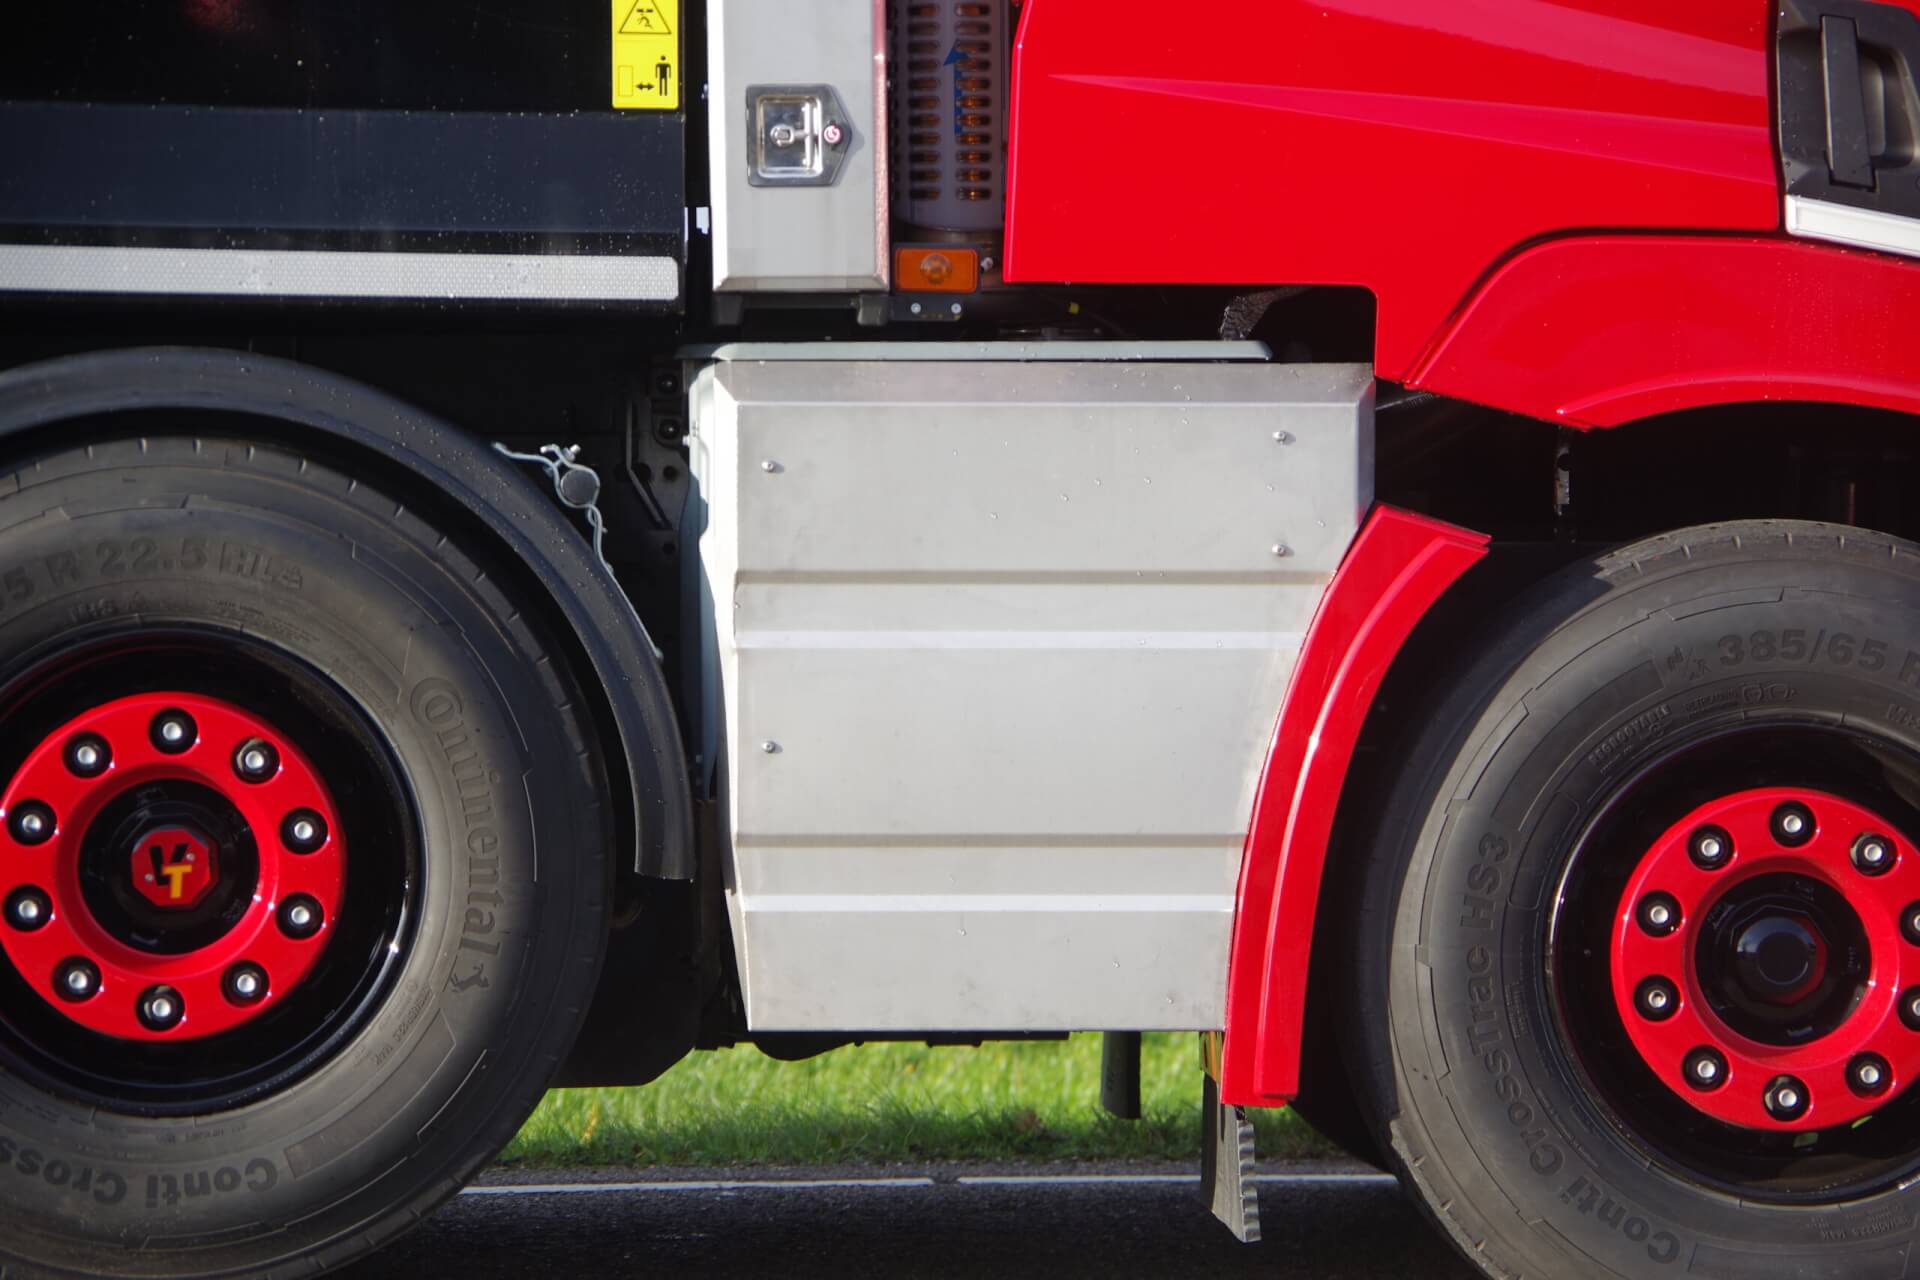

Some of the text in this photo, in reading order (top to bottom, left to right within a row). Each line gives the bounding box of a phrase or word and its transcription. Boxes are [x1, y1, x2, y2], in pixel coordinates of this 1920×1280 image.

[0, 565, 36, 612] 5
[95, 535, 210, 577] 22.5
[1716, 627, 1889, 672] 385/65
[408, 676, 504, 957] Continental
[1460, 830, 1511, 931] HS3
[1465, 943, 1565, 1177] CrossTrac
[144, 1156, 279, 1209] Conti
[1557, 1174, 1682, 1265] Conti
